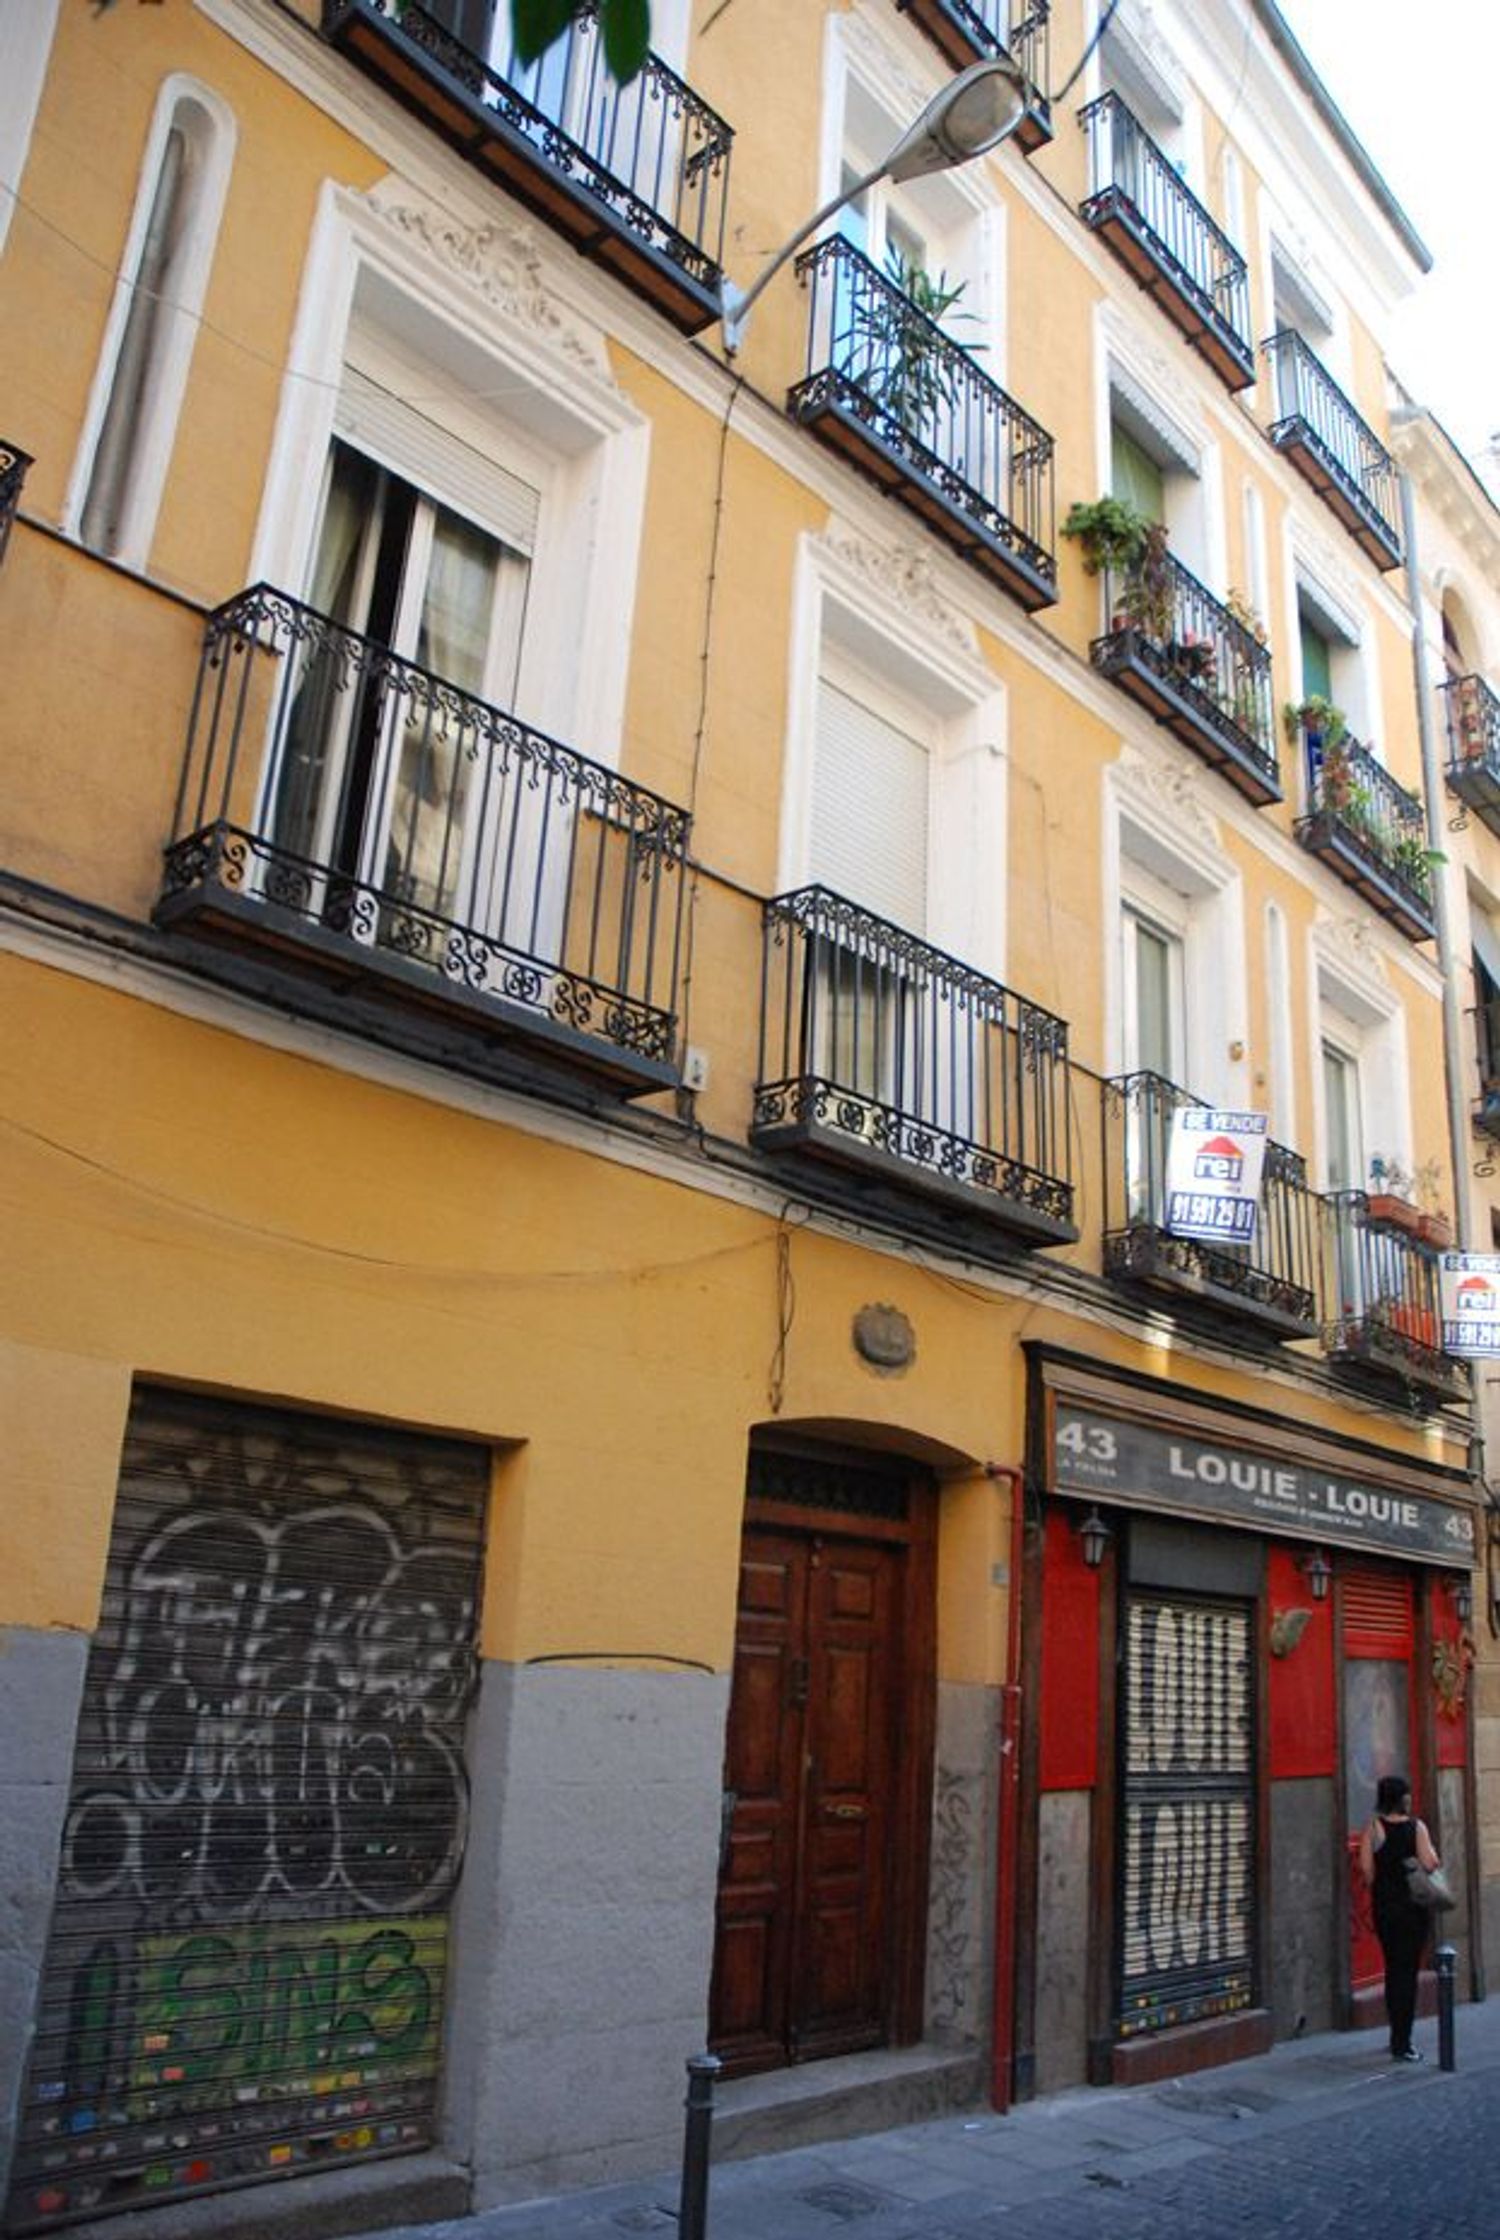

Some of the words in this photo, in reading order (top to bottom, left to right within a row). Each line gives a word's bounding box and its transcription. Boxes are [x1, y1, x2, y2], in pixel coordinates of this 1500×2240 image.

[1056, 1422, 1118, 1461] 43
[1169, 1446, 1298, 1500] LOUIE
[1326, 1485, 1420, 1528] LOUIE
[1444, 1514, 1474, 1541] 43
